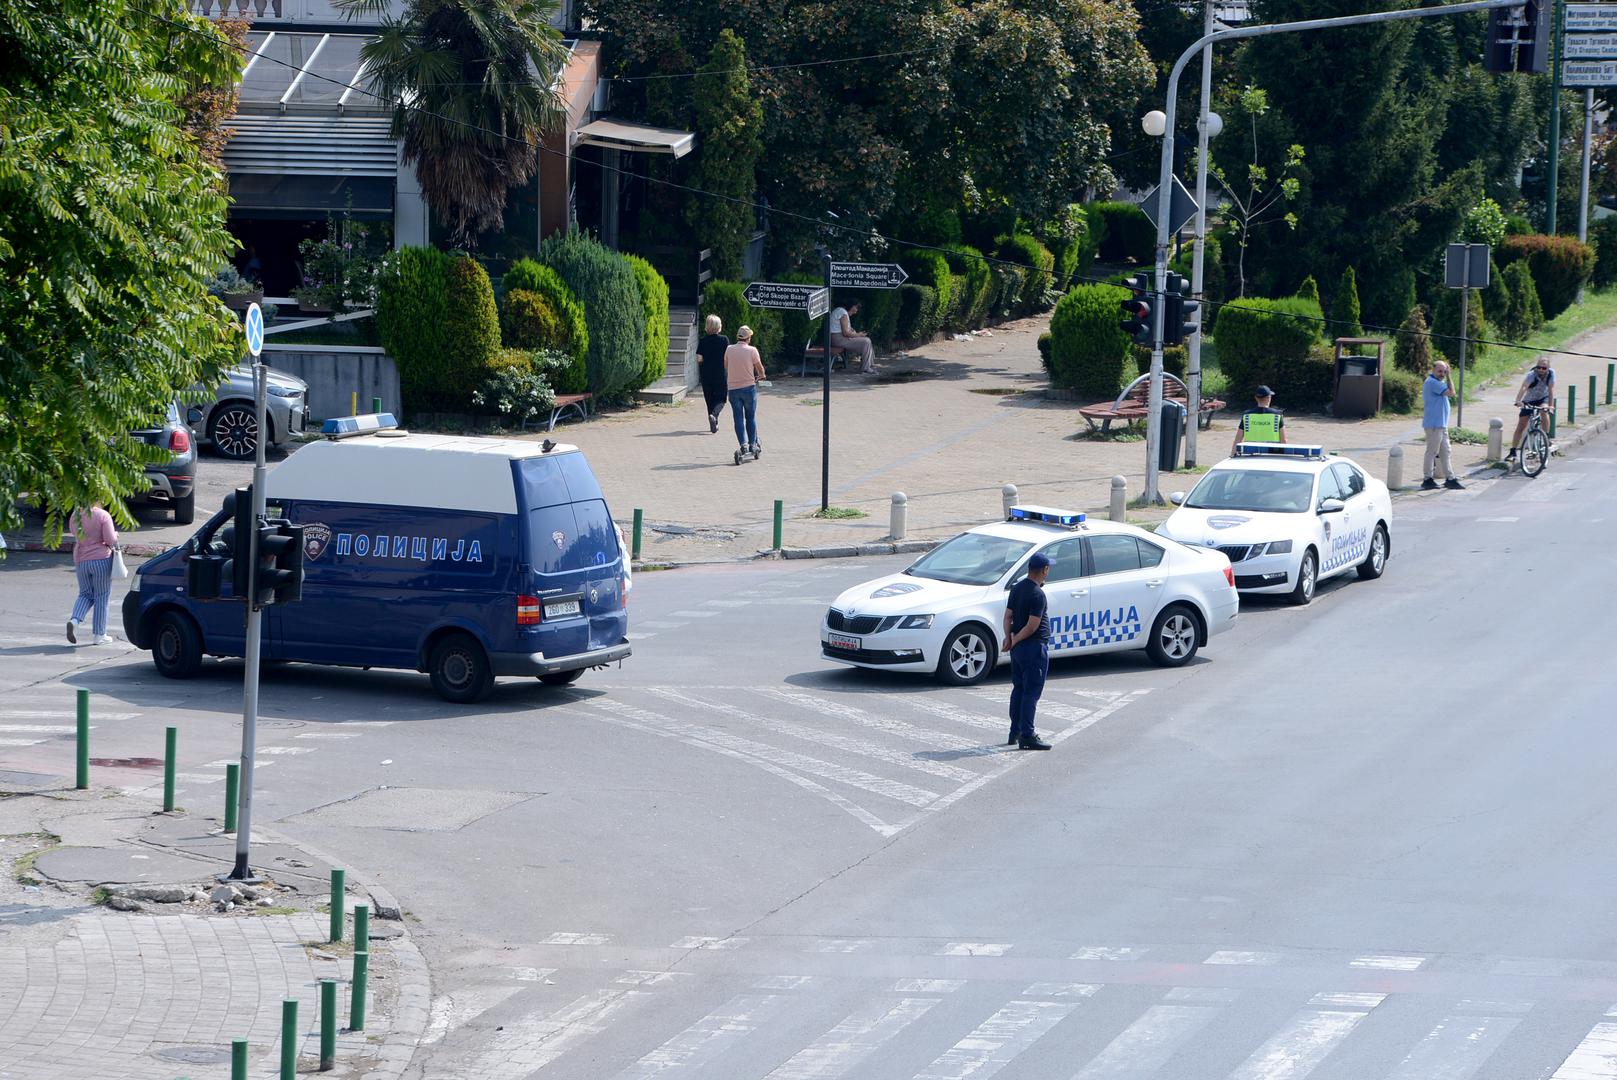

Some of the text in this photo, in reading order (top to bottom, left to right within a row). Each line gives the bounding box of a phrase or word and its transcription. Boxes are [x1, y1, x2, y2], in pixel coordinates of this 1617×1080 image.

[1567, 47, 1578, 55] City
[1602, 46, 1617, 54] Cente
[304, 526, 331, 536] ОЛИЦИЈА
[336, 533, 483, 562] ПОЛИЦИЈА
[1049, 605, 1139, 632] ЛИЦИЈА
